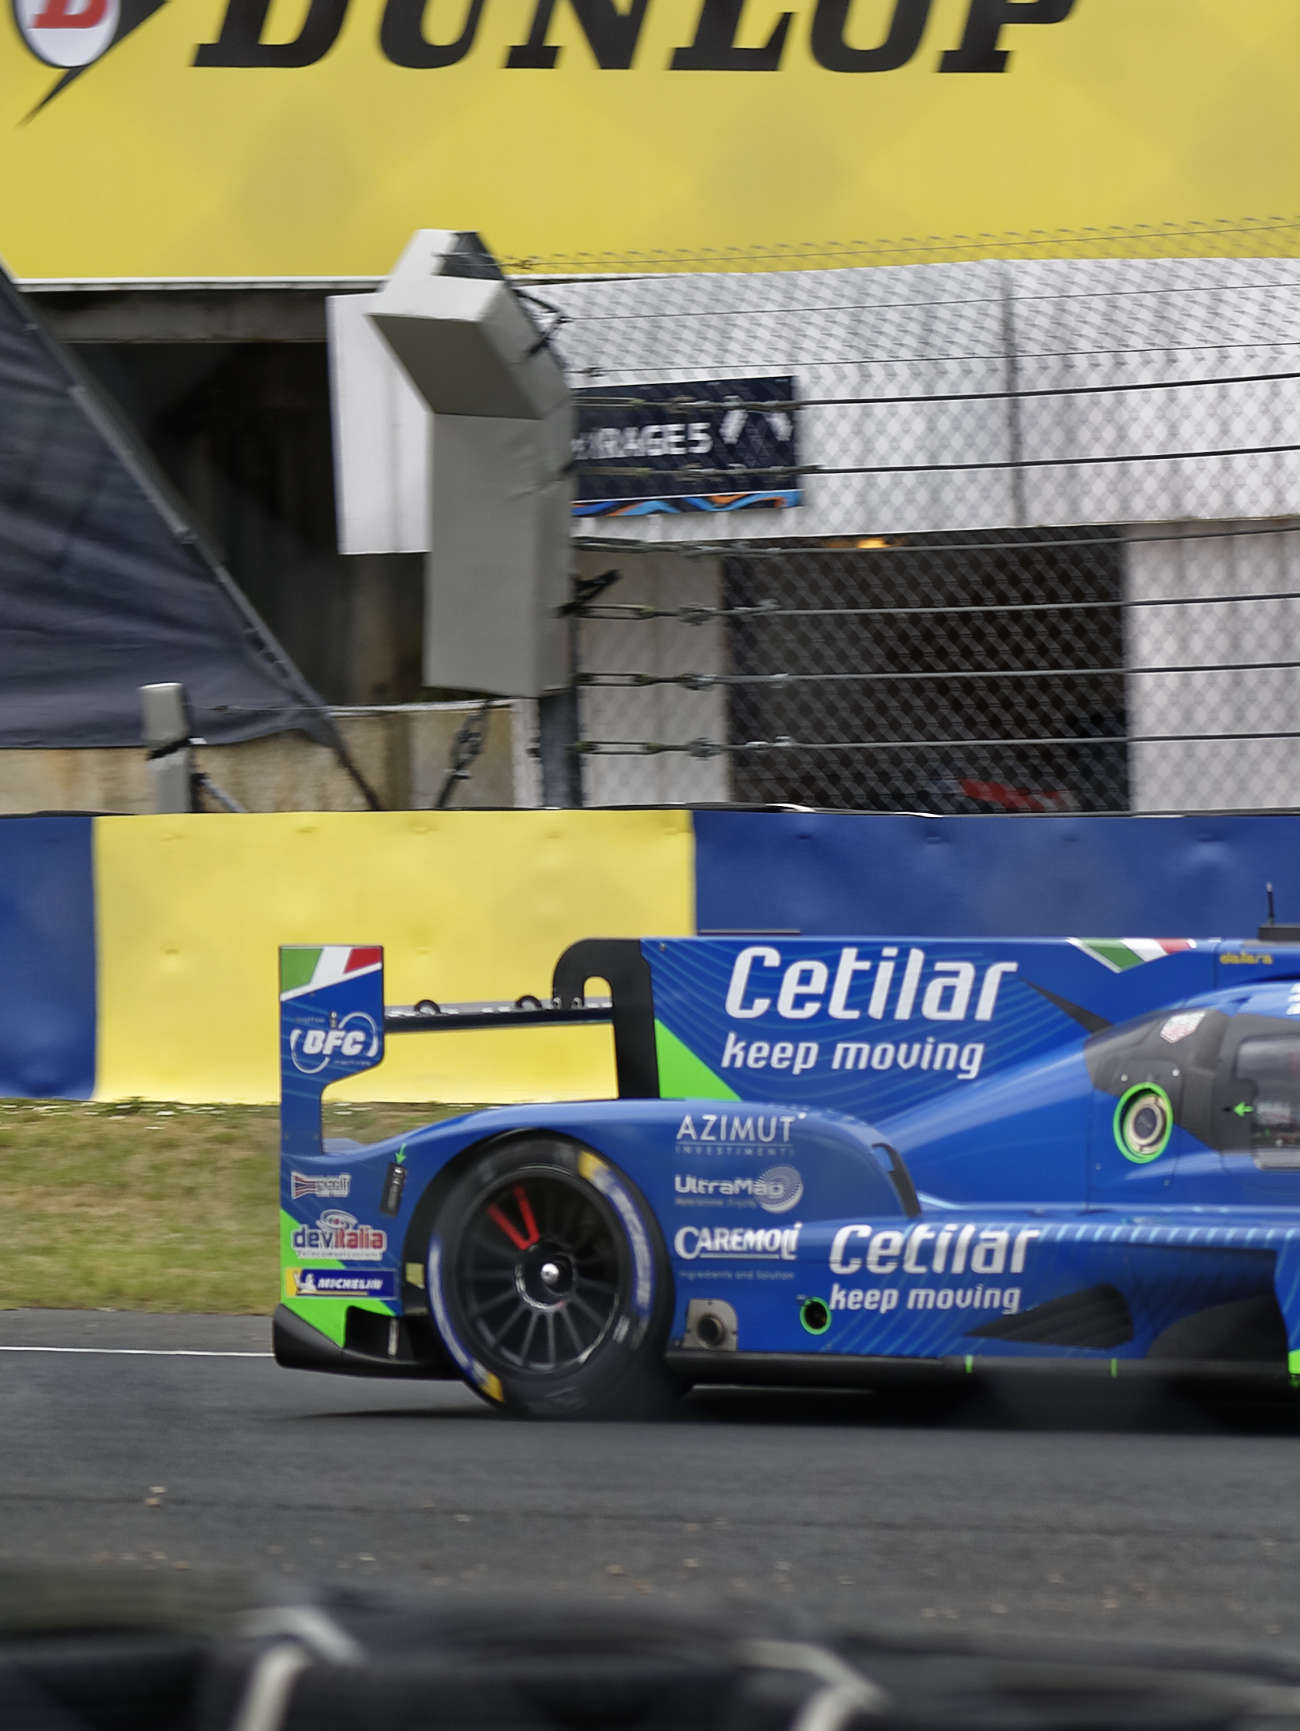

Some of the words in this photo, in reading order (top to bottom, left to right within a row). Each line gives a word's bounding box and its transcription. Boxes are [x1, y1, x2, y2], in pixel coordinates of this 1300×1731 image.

[192, 0, 1075, 73] DUNLOP
[725, 946, 1018, 1021] Cetilar
[721, 1032, 819, 1075] keep
[831, 1037, 984, 1079] moving
[676, 1114, 796, 1142] AZIMUT
[828, 1223, 1040, 1275] Cetilar
[318, 1277, 383, 1290] MICHELIN
[828, 1282, 899, 1314] keep
[906, 1283, 1022, 1315] moving
